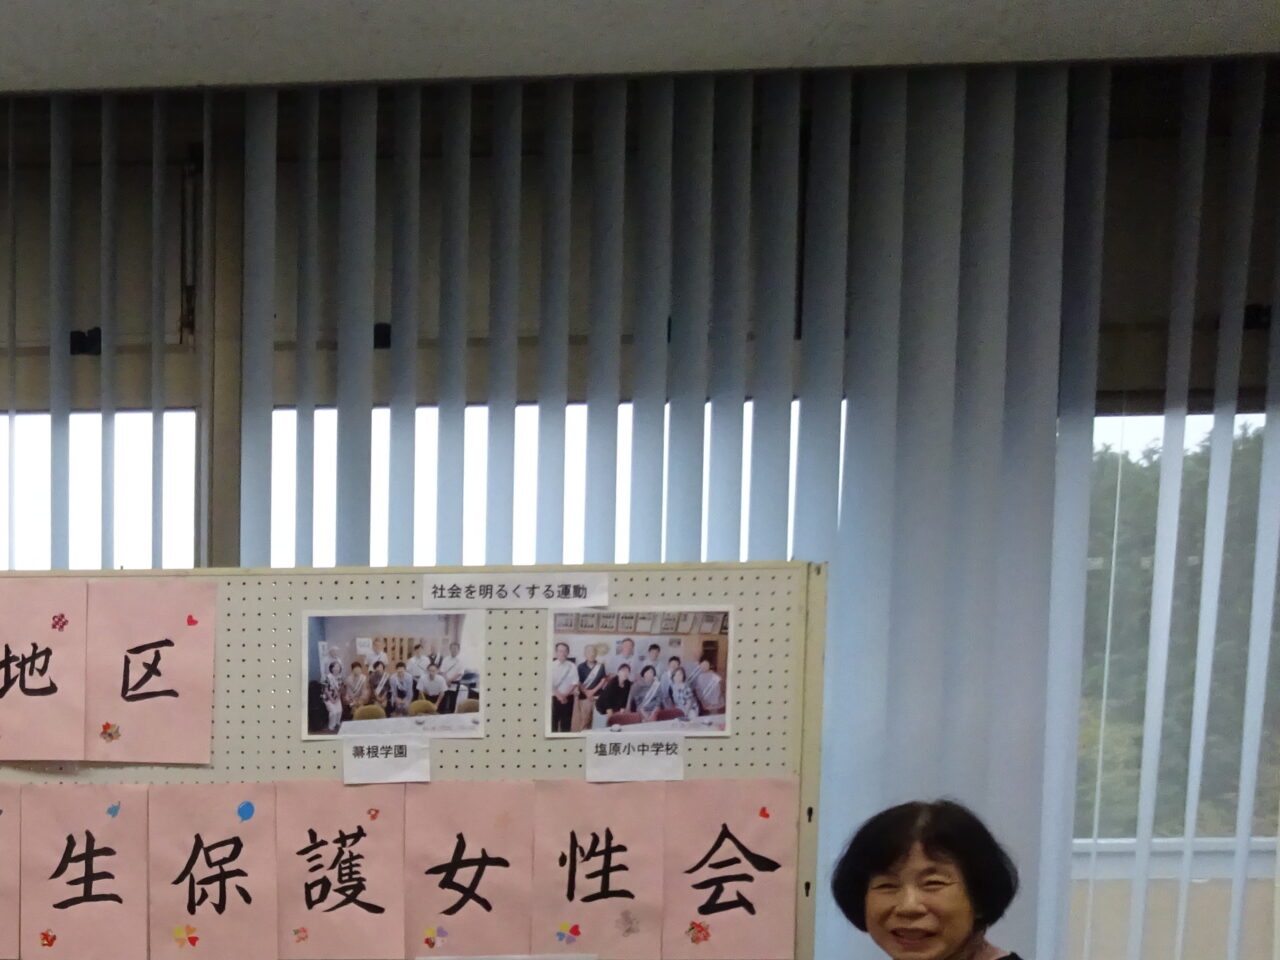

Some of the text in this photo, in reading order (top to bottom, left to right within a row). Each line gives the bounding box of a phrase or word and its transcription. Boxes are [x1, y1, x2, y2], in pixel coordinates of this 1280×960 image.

[431, 583, 588, 601] 社会を明るくする運動
[594, 742, 679, 757] 塩原小中学校
